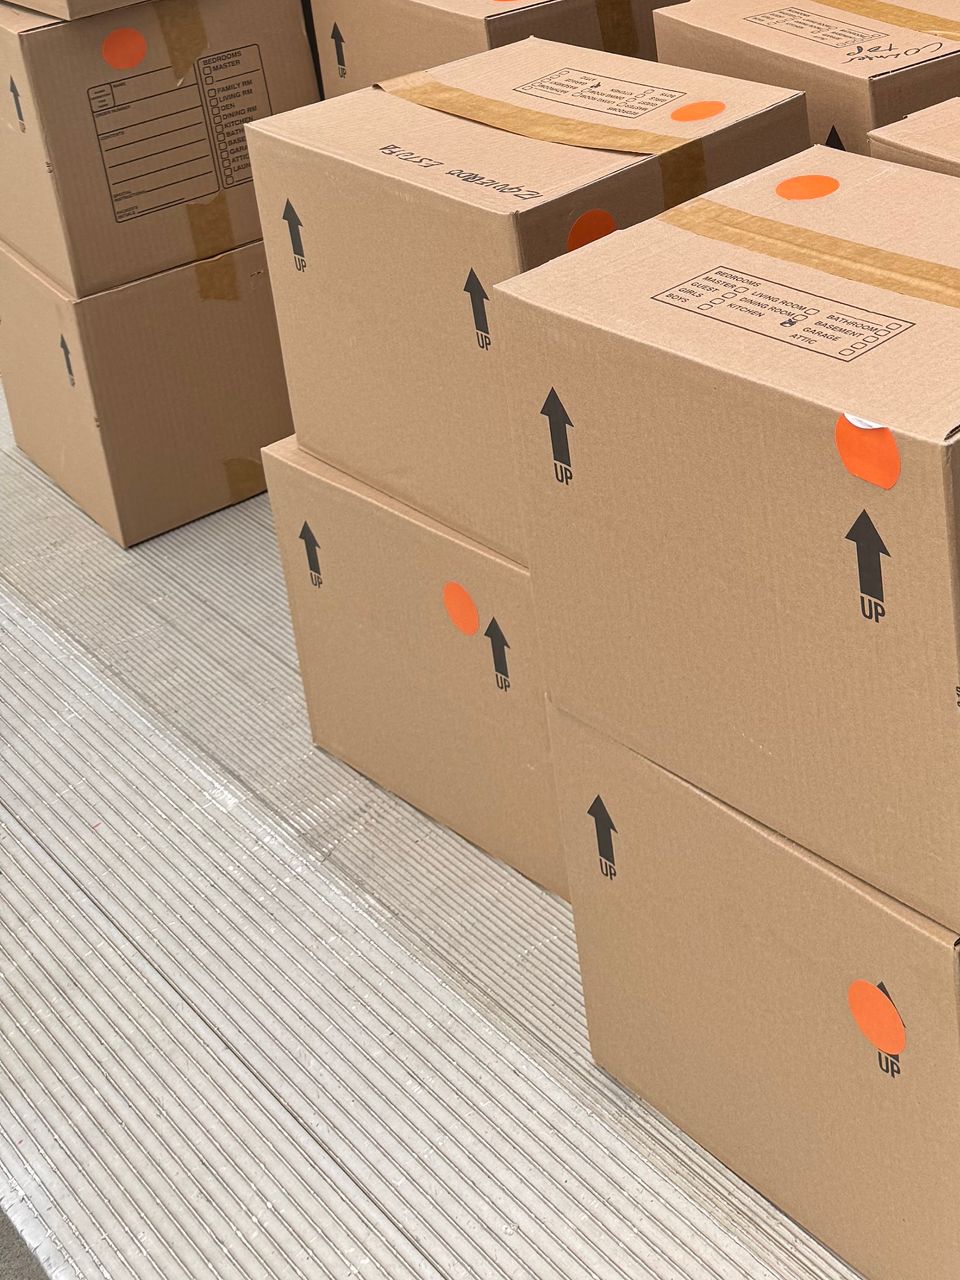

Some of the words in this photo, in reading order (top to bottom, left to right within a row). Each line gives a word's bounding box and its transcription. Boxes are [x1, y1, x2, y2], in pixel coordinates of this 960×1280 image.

[203, 51, 242, 66] BEDROOMS
[212, 59, 241, 71] MASTER
[217, 82, 241, 94] FAMILY
[219, 91, 241, 103] LIVING
[242, 88, 253, 96] RM
[220, 103, 235, 111] DEN
[222, 108, 246, 120] DINING
[294, 256, 306, 273] UP
[702, 275, 737, 290] MASTER
[714, 270, 761, 288] BEDROOMS
[678, 287, 704, 298] GIRLS
[690, 281, 719, 294] GUEST
[665, 292, 689, 303] BOYS
[751, 290, 780, 304] LIVING
[779, 299, 807, 312] ROOM
[727, 303, 765, 318] KITCHEN
[739, 296, 769, 310] DINING
[767, 305, 795, 318] ROOM
[814, 320, 864, 339] BASEMENT
[826, 314, 878, 333] BATHROOM
[476, 332, 491, 351] UP
[789, 333, 817, 345] ATTIC
[802, 326, 841, 342] GARAGE
[554, 462, 572, 486] UP
[310, 572, 322, 588] UP
[860, 596, 886, 623] UP
[496, 673, 510, 692] UP
[600, 857, 616, 880] UP
[878, 1051, 900, 1078] UP
